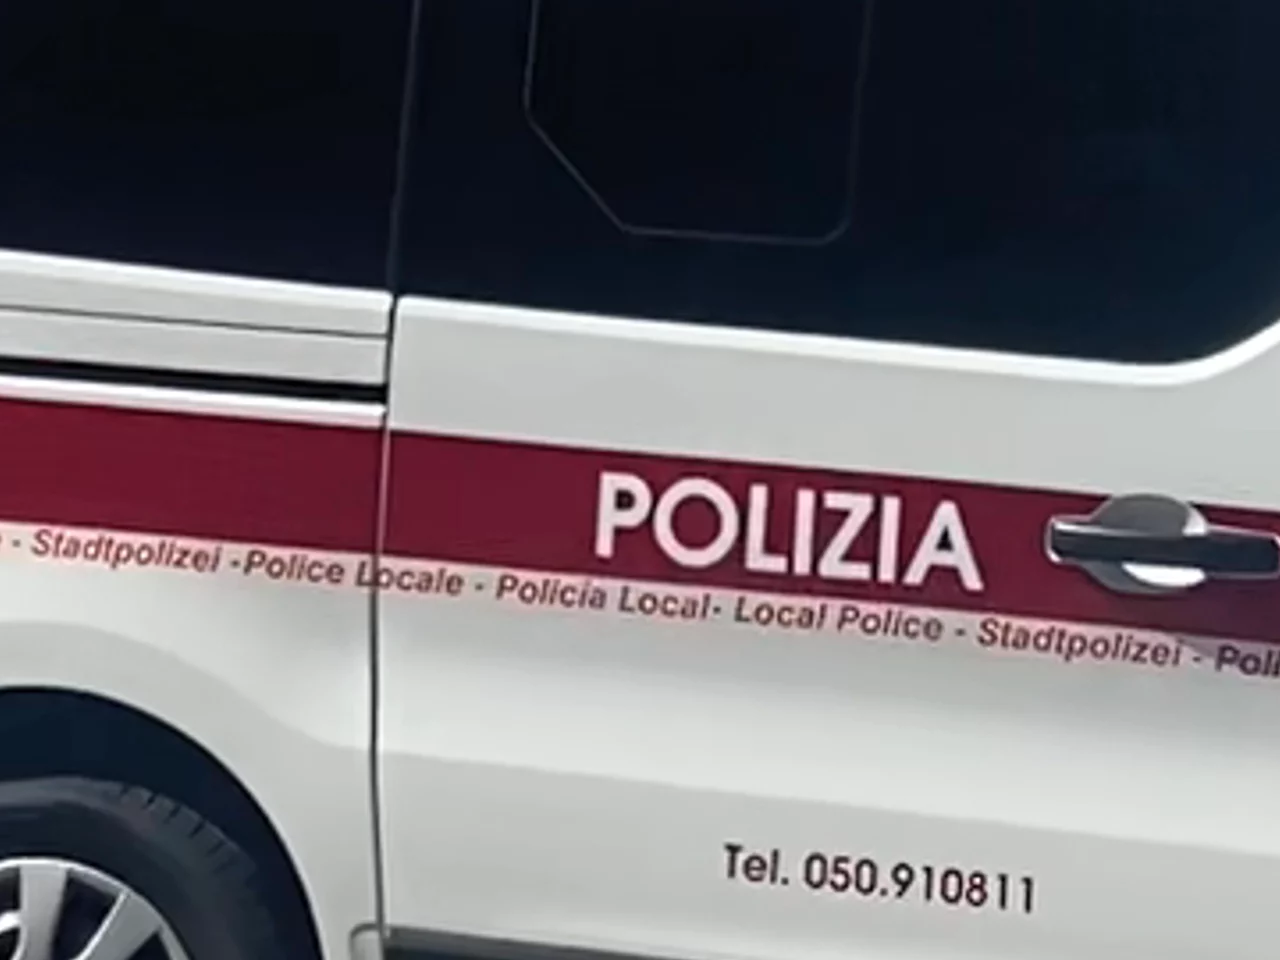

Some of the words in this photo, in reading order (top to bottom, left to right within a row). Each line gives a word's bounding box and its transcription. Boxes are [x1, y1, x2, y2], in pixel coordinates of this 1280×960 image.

[595, 471, 984, 591] POLIZIA
[30, 528, 223, 573] Stadtpolizei
[355, 561, 465, 597] Locale
[734, 597, 826, 631] Local
[836, 605, 943, 641] Police
[976, 617, 1184, 667] Stadtpolizei
[724, 842, 789, 885] Tel.
[803, 852, 1033, 913] 050.910811
